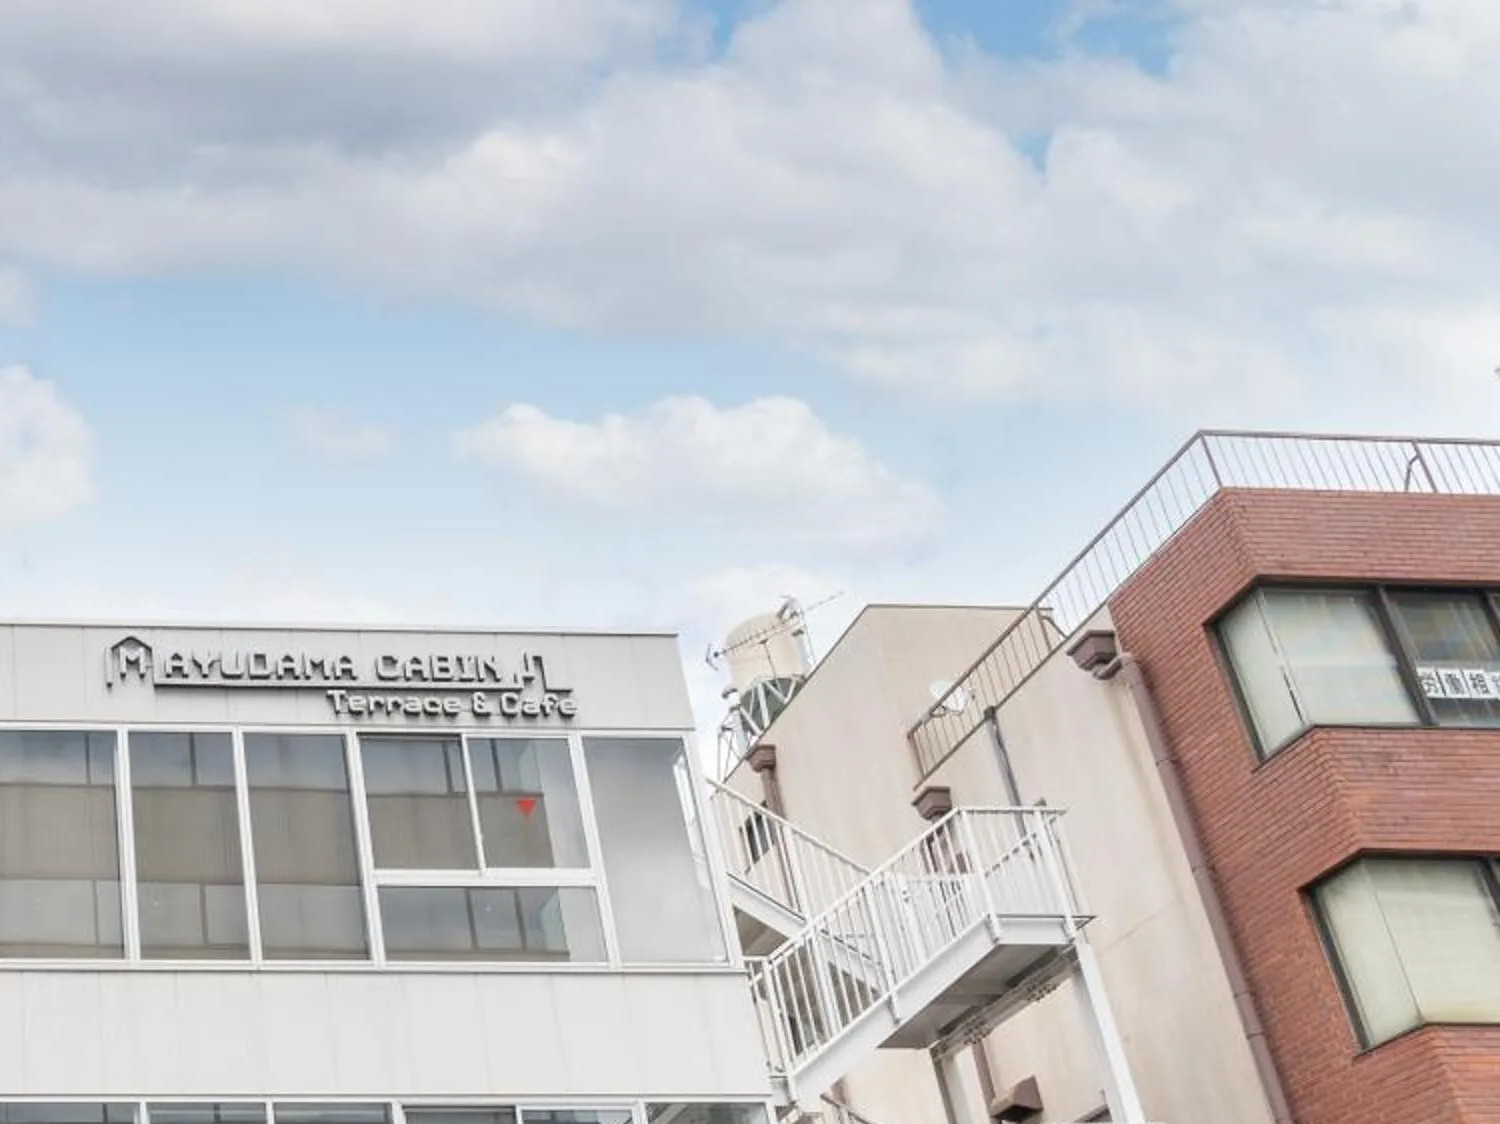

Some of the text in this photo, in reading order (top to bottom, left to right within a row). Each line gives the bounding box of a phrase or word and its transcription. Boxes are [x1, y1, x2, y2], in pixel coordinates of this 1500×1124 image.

[117, 646, 502, 684] MAYUDAMA CABIN
[326, 688, 580, 718] Terrace & Cafe
